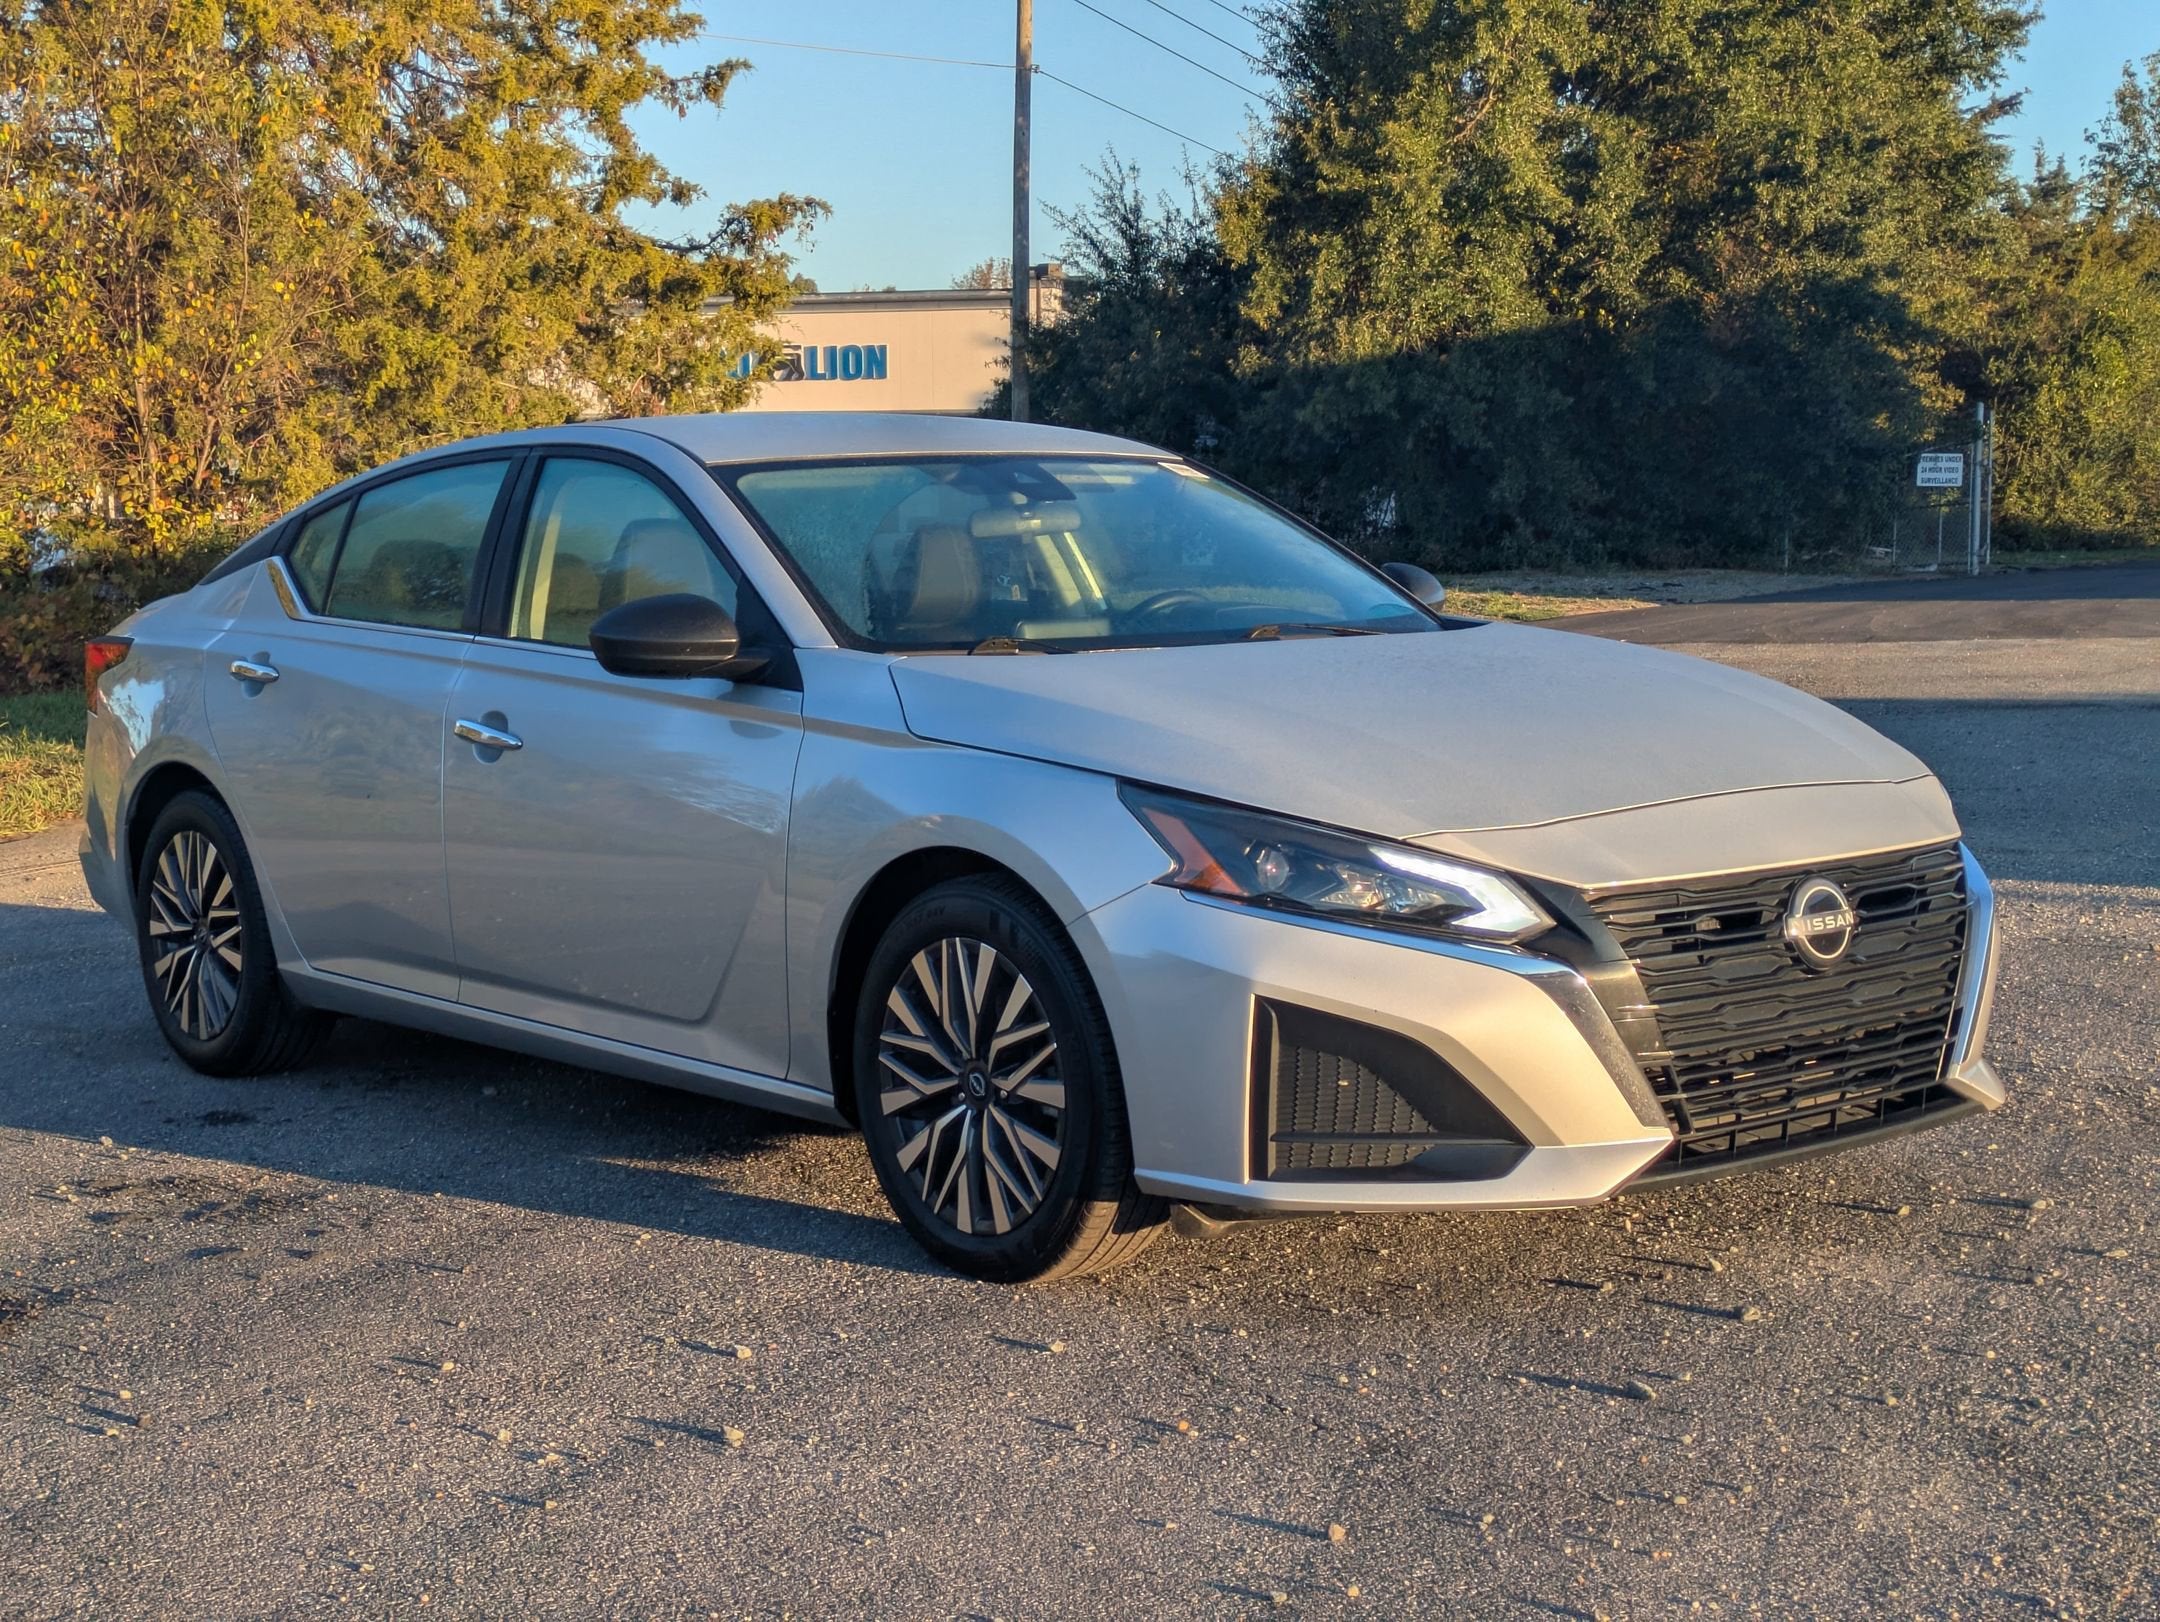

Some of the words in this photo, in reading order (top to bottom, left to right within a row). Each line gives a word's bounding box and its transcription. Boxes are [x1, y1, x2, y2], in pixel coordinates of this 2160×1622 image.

[1920, 455, 1944, 463] REMISES
[1944, 455, 1962, 463] UNDER
[1920, 466, 1927, 474] 24
[1928, 466, 1943, 474] HOUR
[1943, 466, 1959, 474] VIDEO
[1791, 911, 1854, 934] NISSAN
